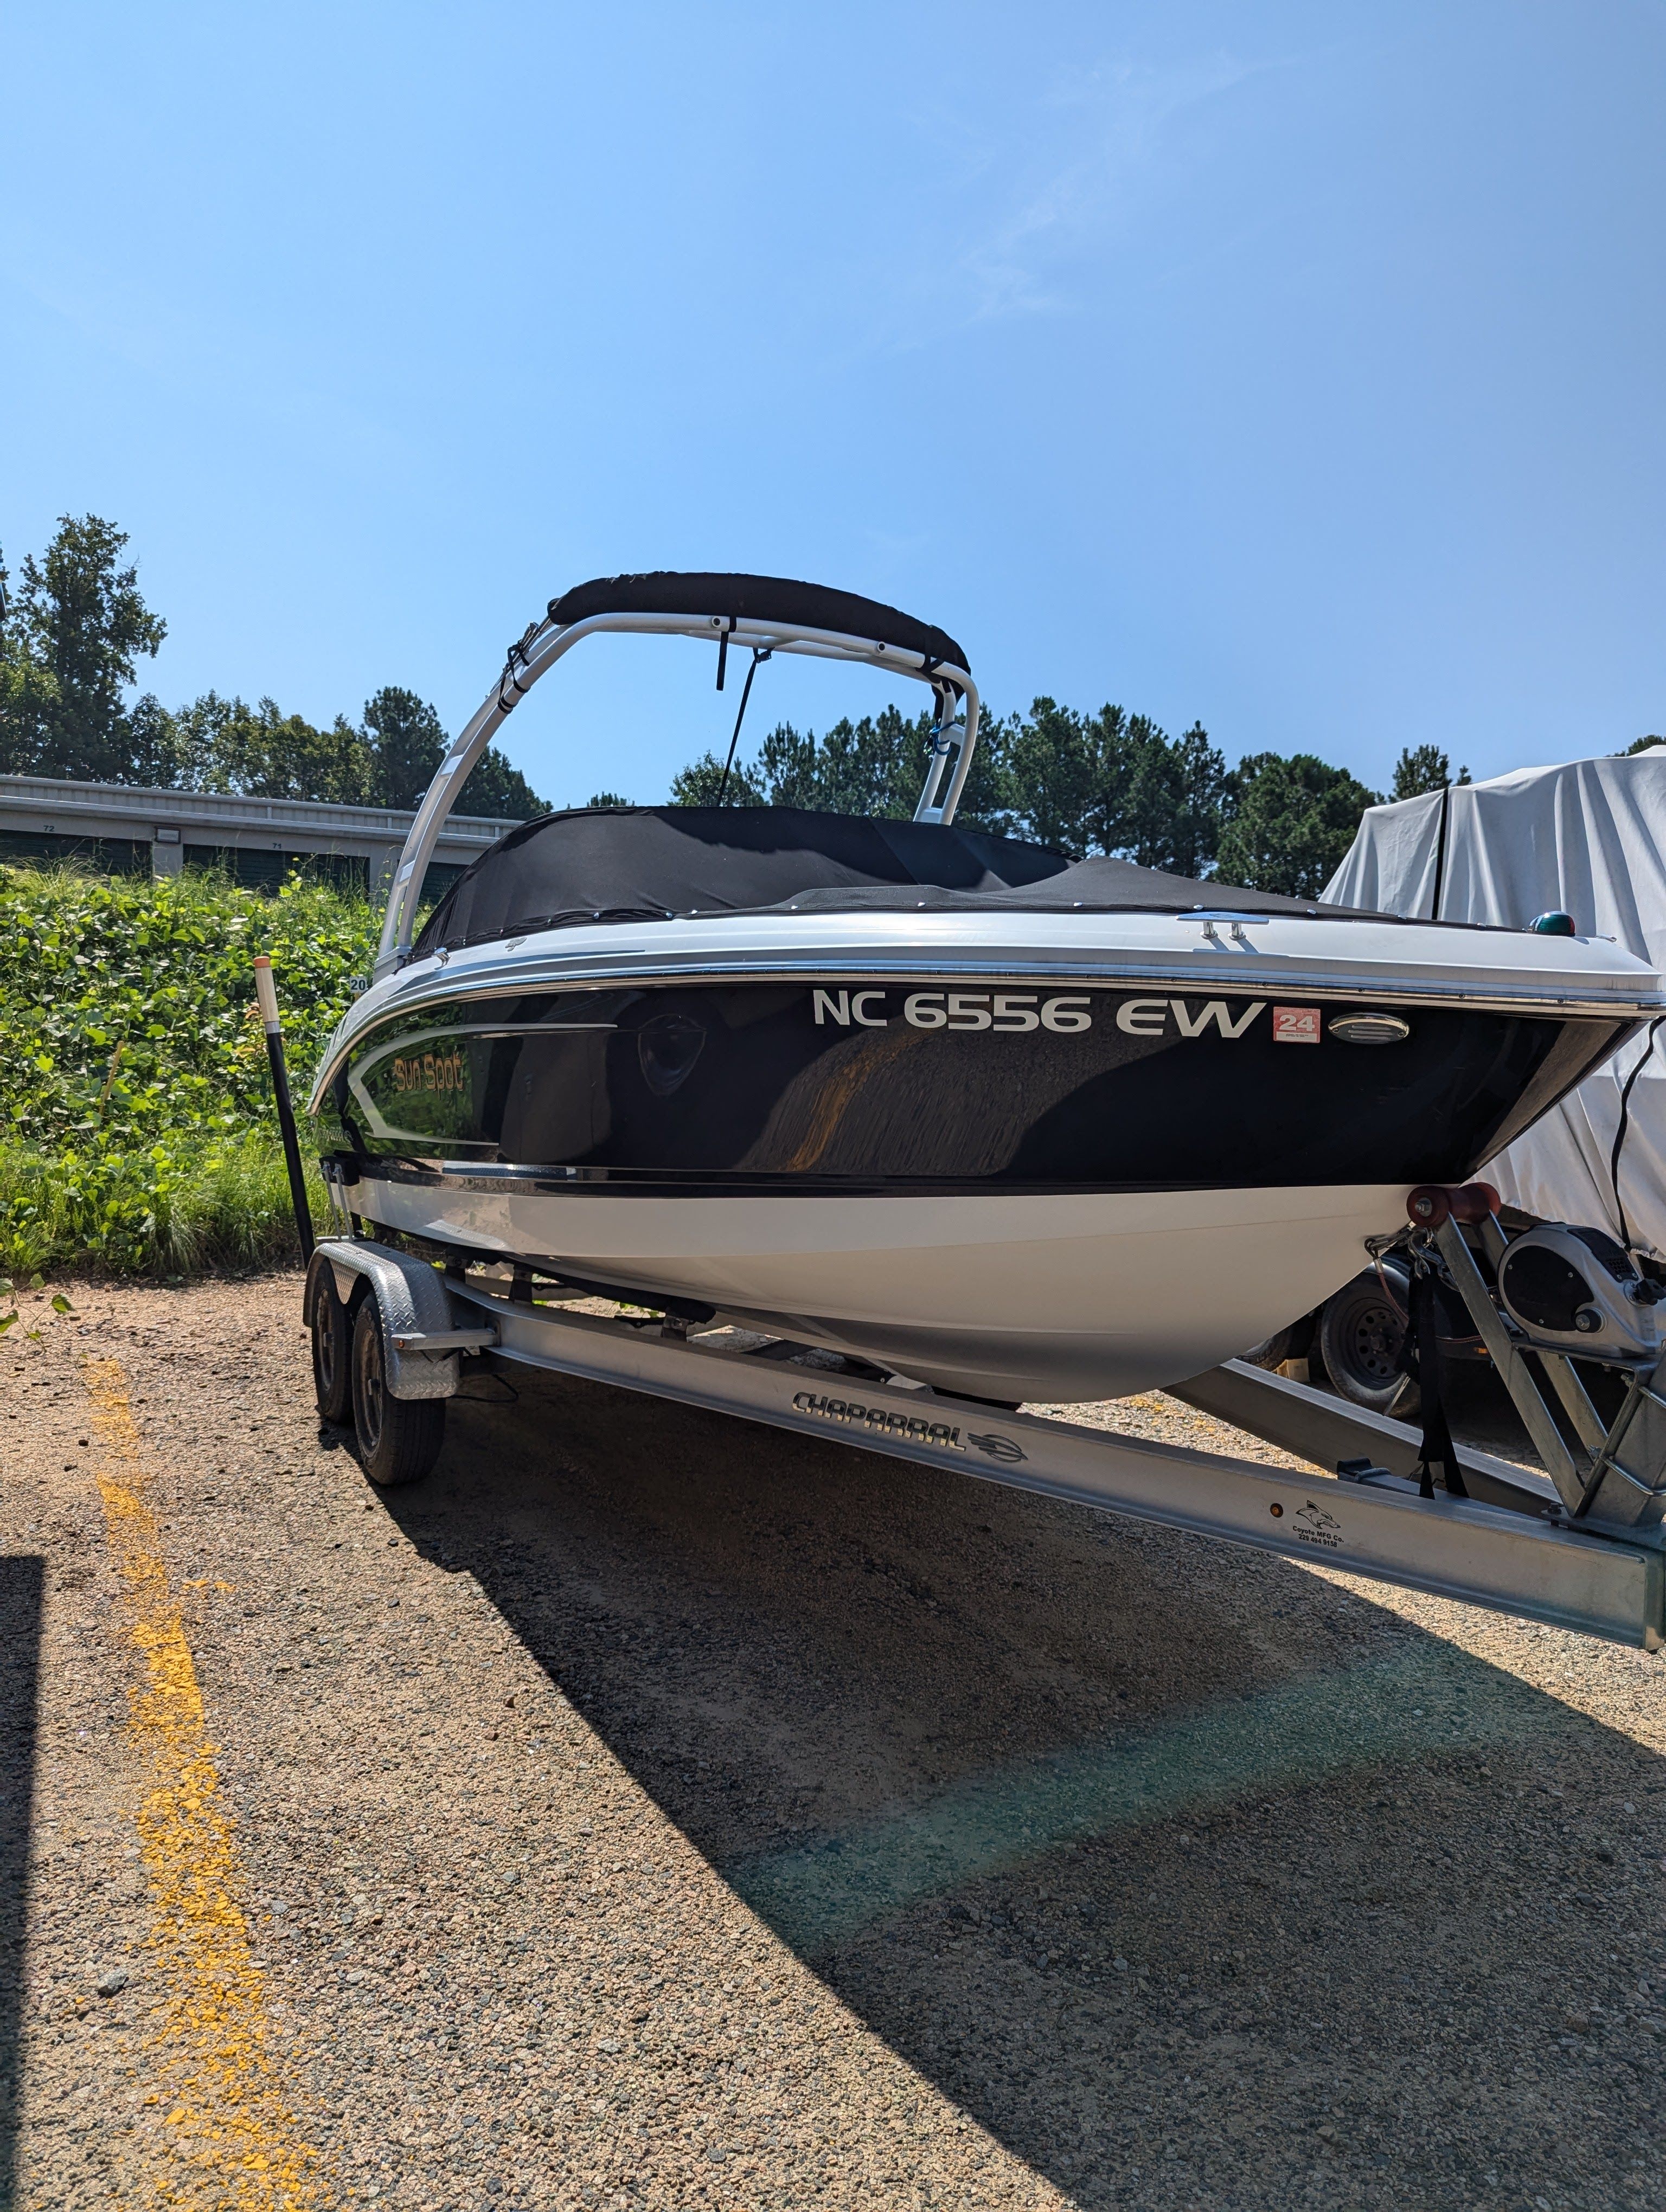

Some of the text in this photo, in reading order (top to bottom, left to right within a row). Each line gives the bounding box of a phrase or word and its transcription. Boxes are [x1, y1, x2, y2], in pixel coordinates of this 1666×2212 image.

[351, 980, 366, 990] 20
[813, 989, 1267, 1038] NC 6556 EW
[1279, 1014, 1315, 1032] 24
[394, 1052, 464, 1100] Sun Spot
[792, 1392, 966, 1451] CHAPARRAL
[1292, 1526, 1344, 1543] Coyote MFG Co.
[1323, 1539, 1337, 1548] 9158
